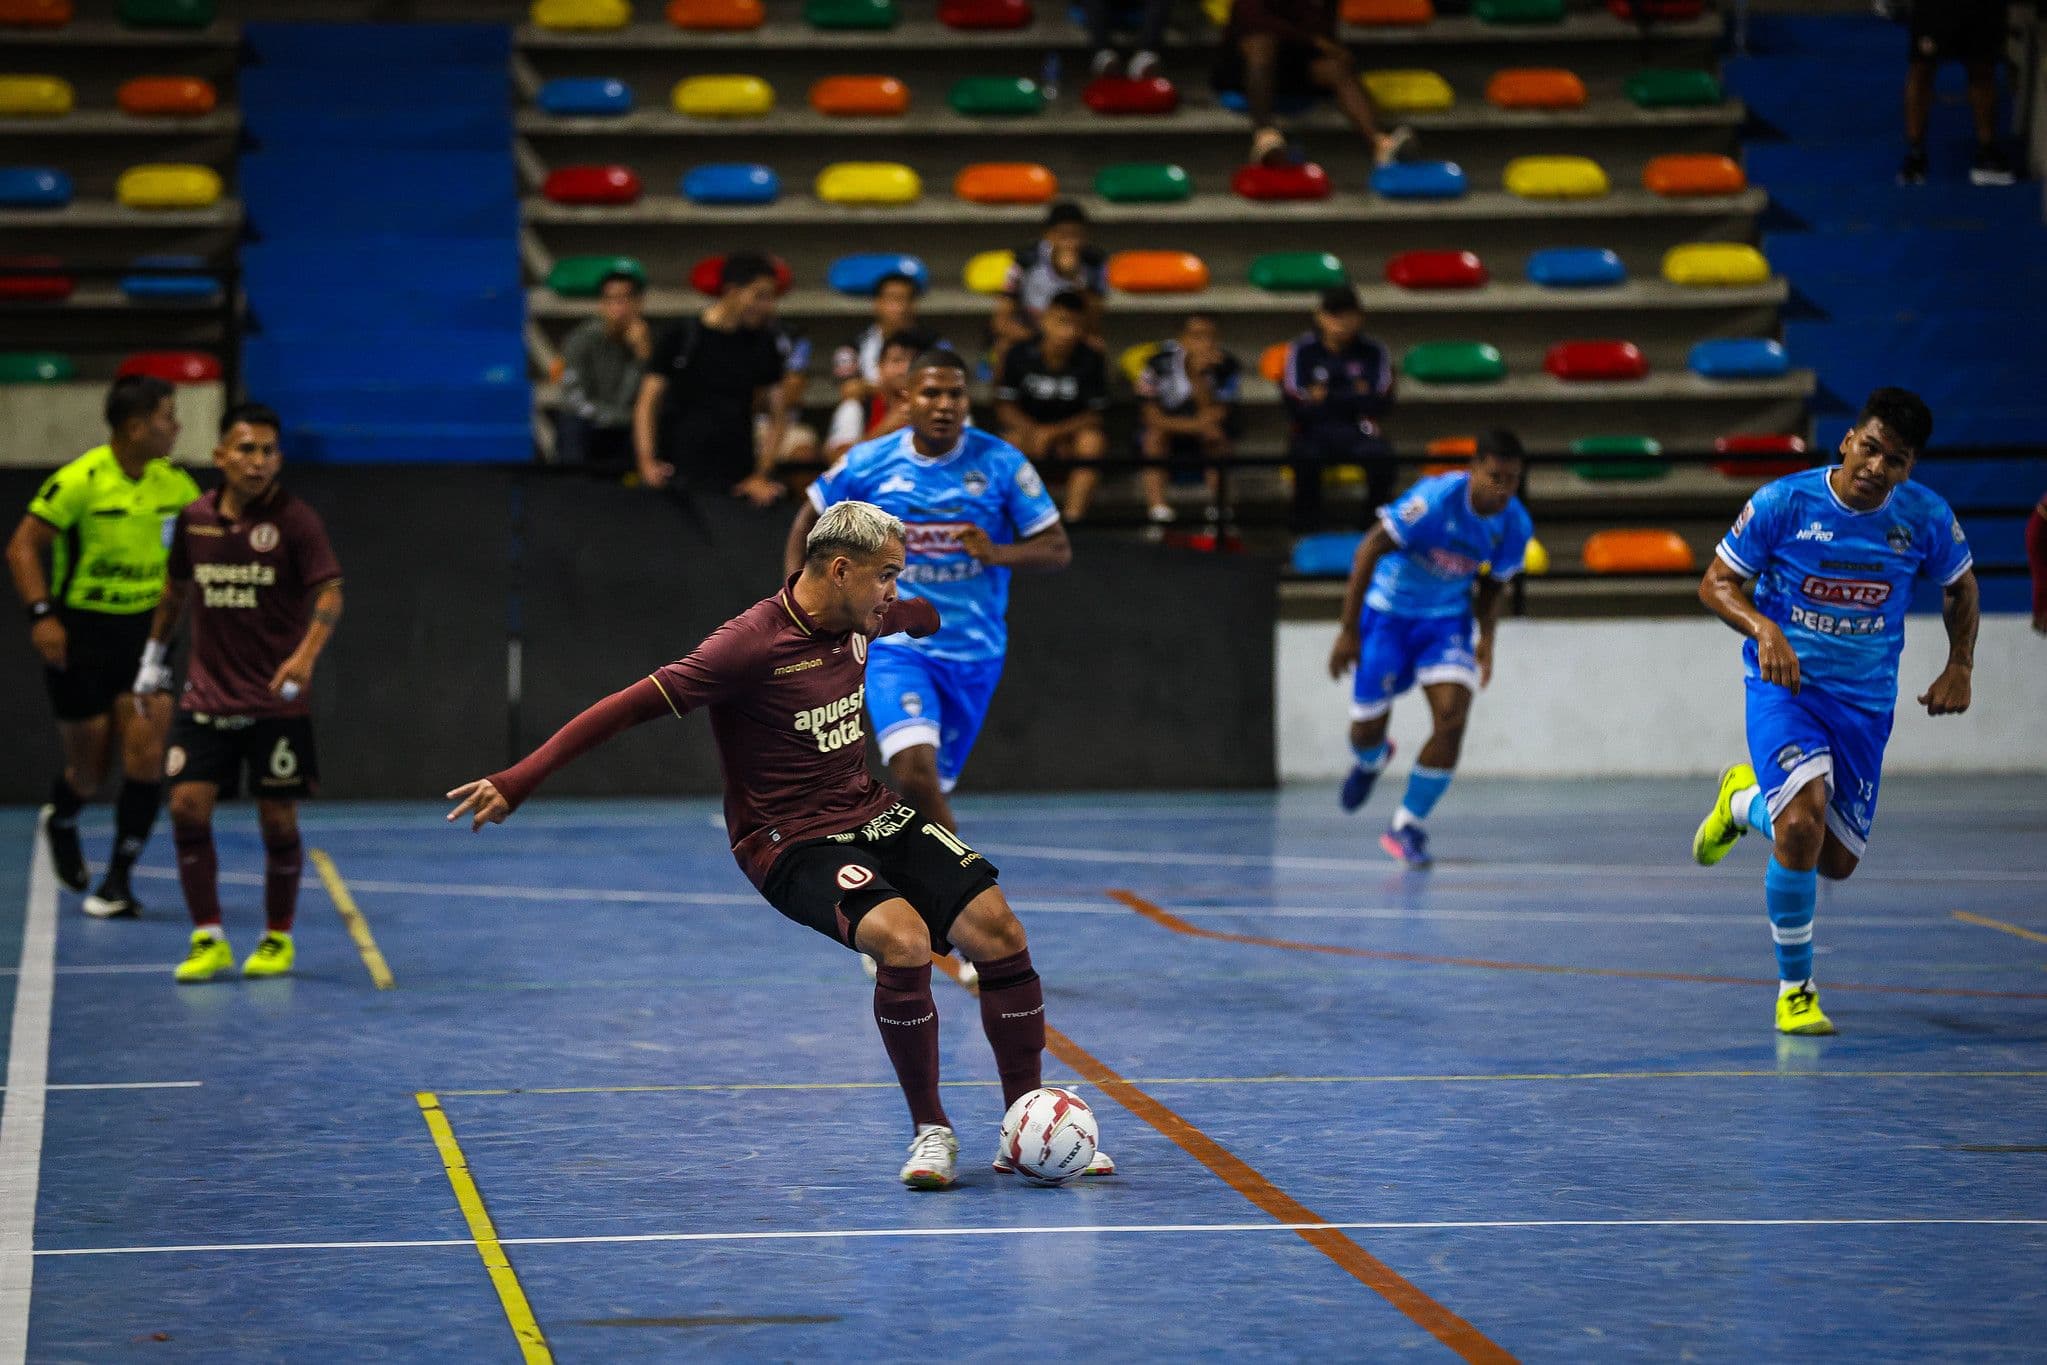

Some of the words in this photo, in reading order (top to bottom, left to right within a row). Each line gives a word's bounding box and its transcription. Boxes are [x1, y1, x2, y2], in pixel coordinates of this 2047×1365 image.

[774, 658, 823, 675] marathon
[794, 683, 865, 734] apuest
[816, 714, 865, 752] total
[270, 736, 297, 778] 6
[841, 866, 868, 884] U
